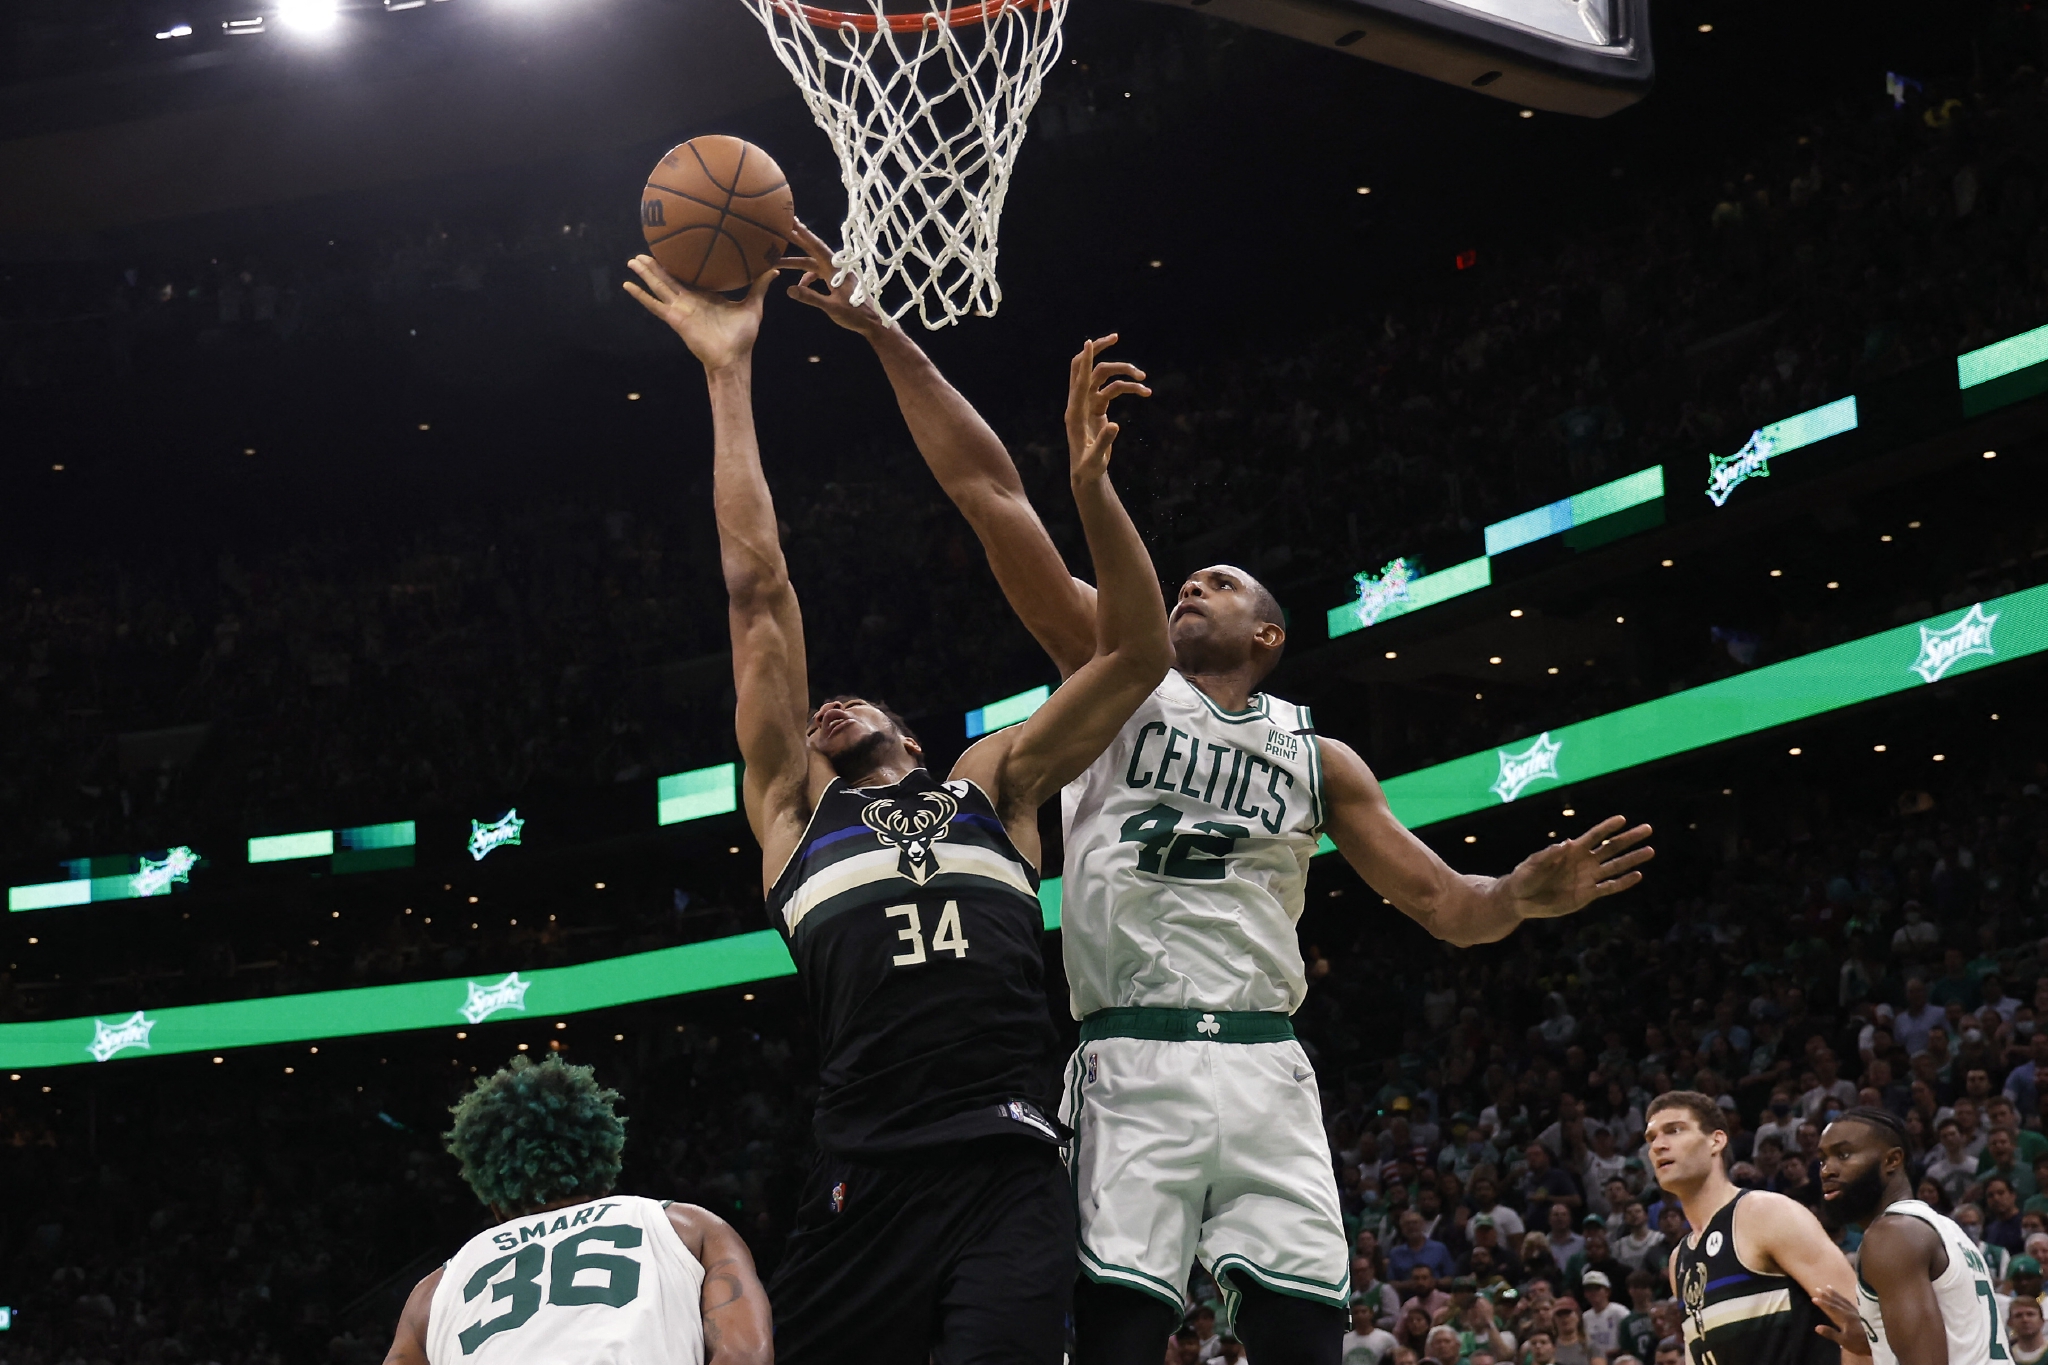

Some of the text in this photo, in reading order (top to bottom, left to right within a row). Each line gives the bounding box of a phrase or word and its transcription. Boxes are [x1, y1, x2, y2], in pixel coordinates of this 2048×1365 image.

[1920, 624, 1987, 668] Sprite
[1265, 742, 1298, 761] PRINT
[1268, 729, 1298, 751] VISTA
[1126, 721, 1294, 834] CELTICS
[1500, 750, 1551, 789] Sprite
[473, 824, 518, 849] Sprite
[1119, 803, 1250, 879] 42
[885, 900, 969, 966] 34
[468, 986, 521, 1013] Sprite
[95, 1025, 147, 1051] Sprite
[493, 1203, 622, 1251] SMART
[458, 1224, 643, 1356] 36
